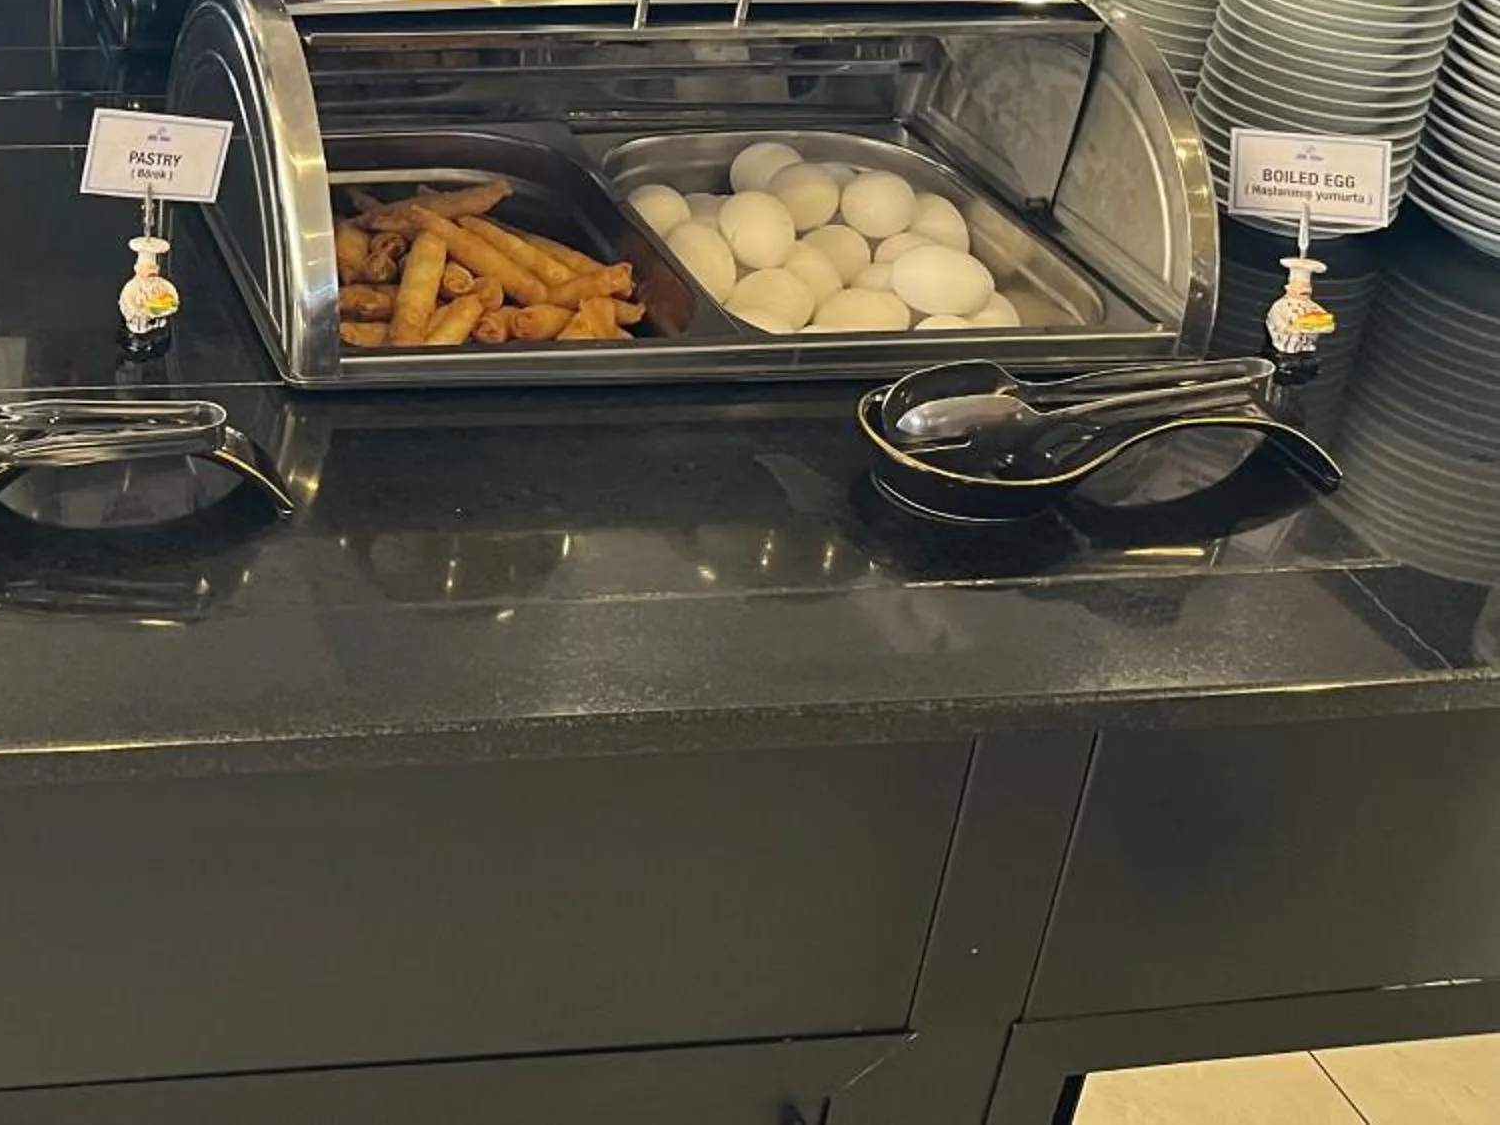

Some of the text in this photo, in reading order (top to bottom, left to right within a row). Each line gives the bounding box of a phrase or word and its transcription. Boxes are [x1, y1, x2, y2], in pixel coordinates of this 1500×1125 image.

[129, 150, 183, 167] PASTRY
[1262, 168, 1356, 189] BOILED EGG
[1315, 190, 1365, 204] yumurta
